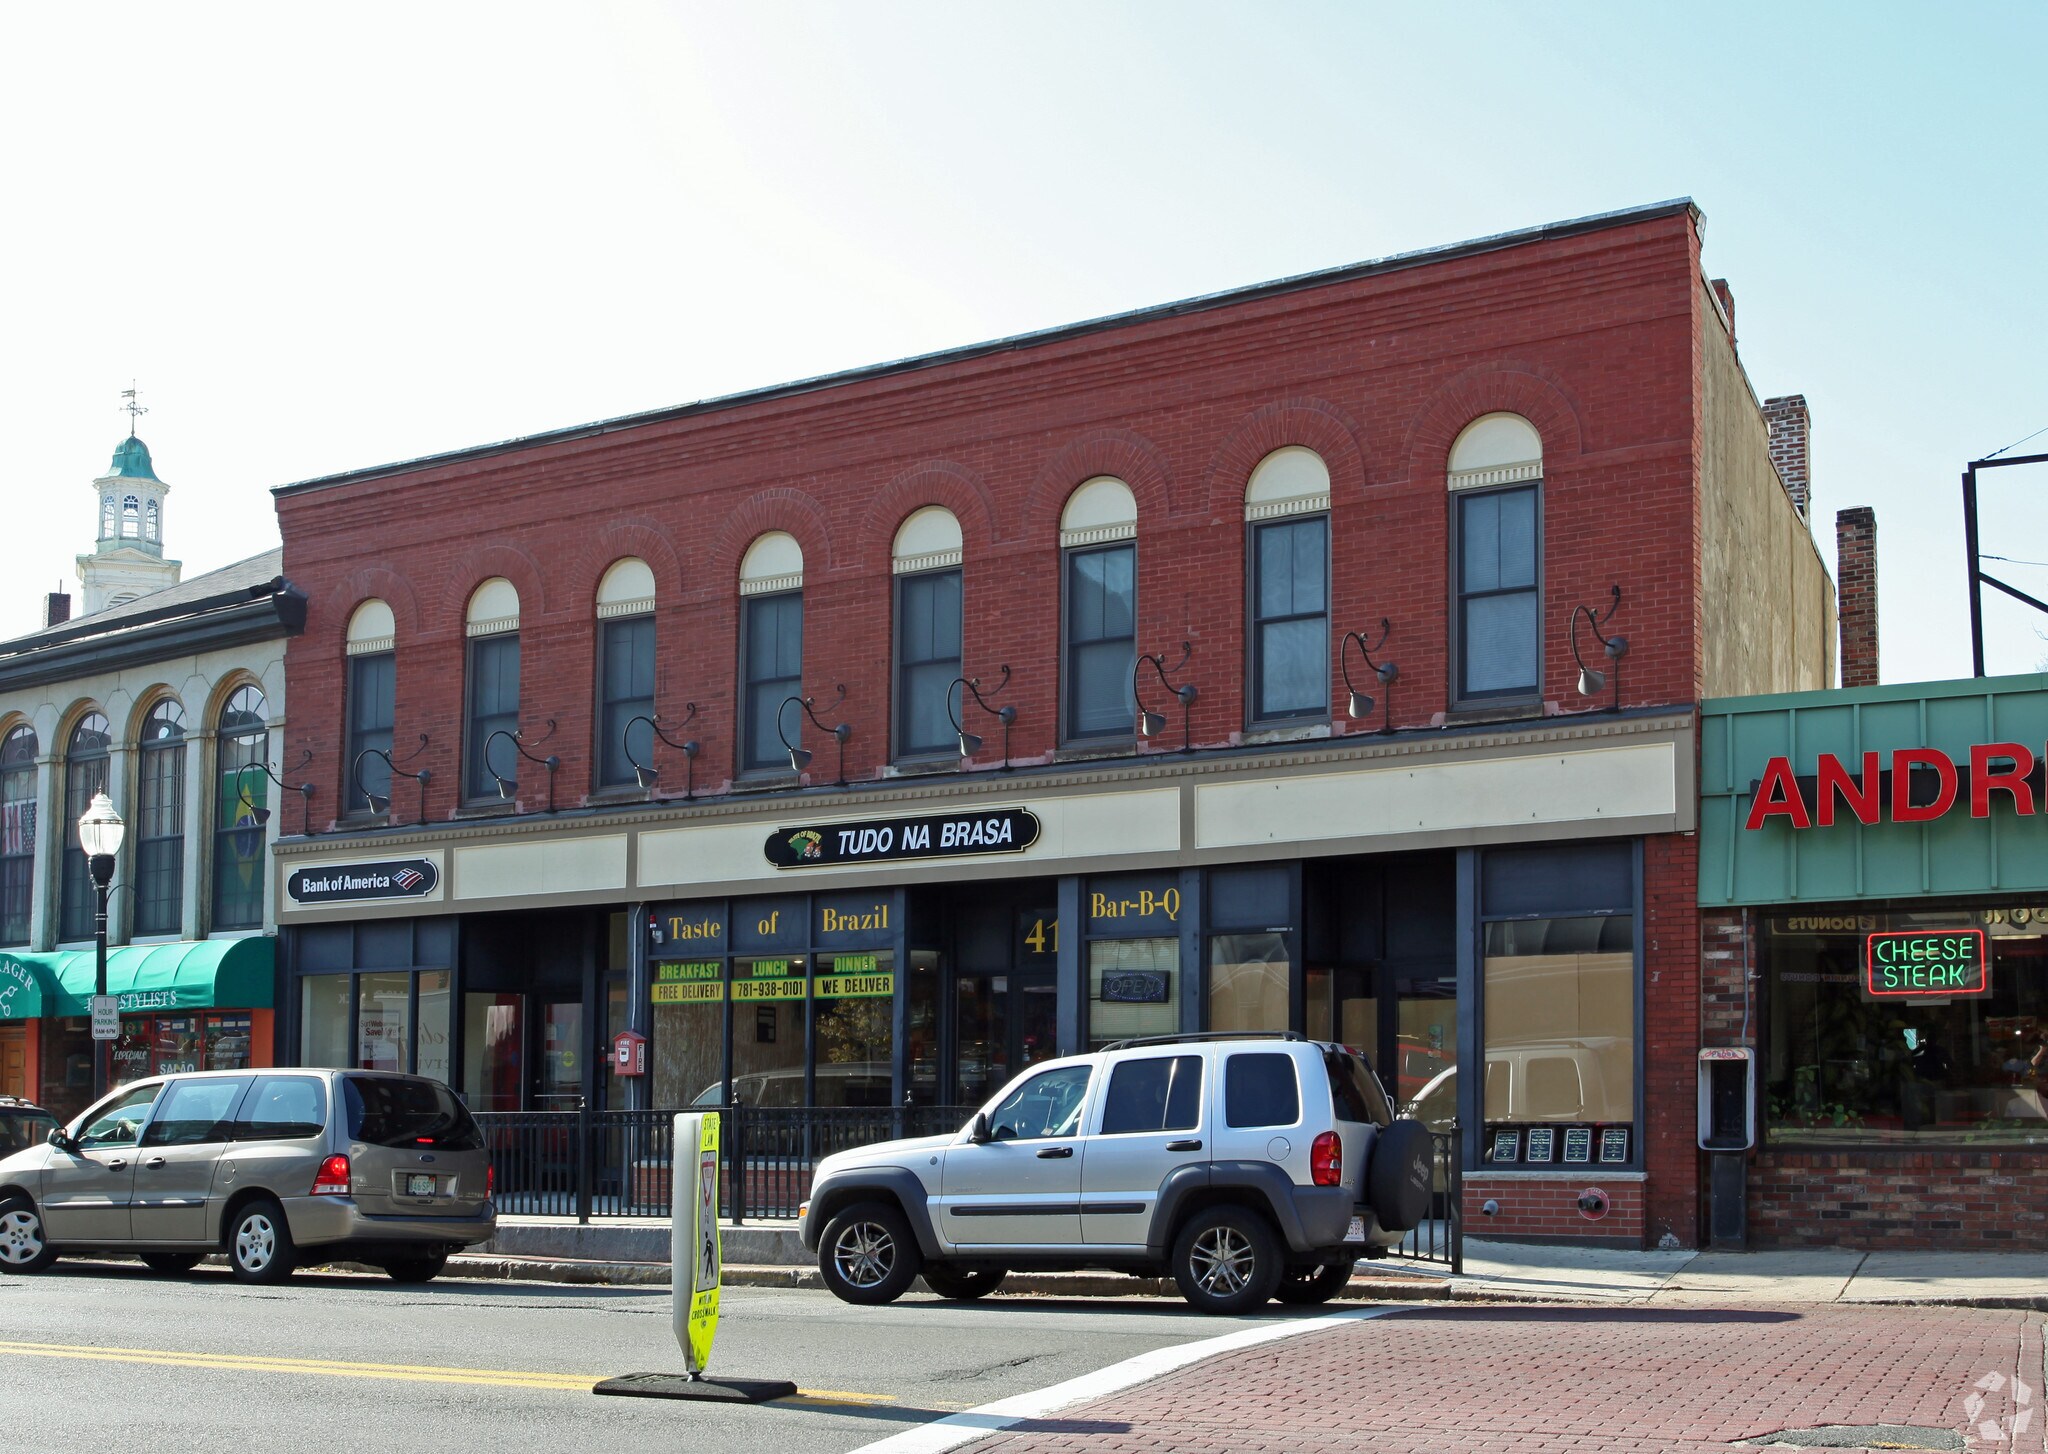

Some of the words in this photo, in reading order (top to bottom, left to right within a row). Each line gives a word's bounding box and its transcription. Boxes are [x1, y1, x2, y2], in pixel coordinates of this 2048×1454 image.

[1744, 740, 2048, 830] ANDR
[838, 827, 894, 855] TUDO
[901, 824, 931, 851] NA
[940, 818, 1013, 848] BRASA
[302, 877, 331, 894] Bank
[331, 876, 344, 891] of
[343, 873, 390, 890] America
[1090, 887, 1181, 922] Bar-B-Q
[669, 915, 721, 940] Taste
[758, 911, 779, 936] of
[822, 904, 889, 932] Brazil
[1876, 937, 1973, 963] CHEESE
[659, 962, 720, 980] BREAKFAST
[752, 960, 788, 977] LUNCH
[834, 955, 877, 973] DINNER
[0, 960, 33, 992] AGER
[1883, 964, 1965, 988] STEAK
[658, 984, 681, 1000] FREE
[682, 983, 721, 999] DELIVERY
[737, 981, 803, 998] 781-938-0101
[822, 980, 839, 994] WE
[845, 977, 890, 993] DELIVER
[1110, 978, 1155, 994] OPEN
[119, 990, 177, 1009] STYLISTS
[98, 1008, 113, 1016] HOUR
[94, 1018, 117, 1026] PARKING
[703, 1117, 719, 1130] STATE
[704, 1133, 713, 1147] LAW
[1413, 1153, 1429, 1182] Jeep
[691, 1306, 716, 1320] CROSSWALK
